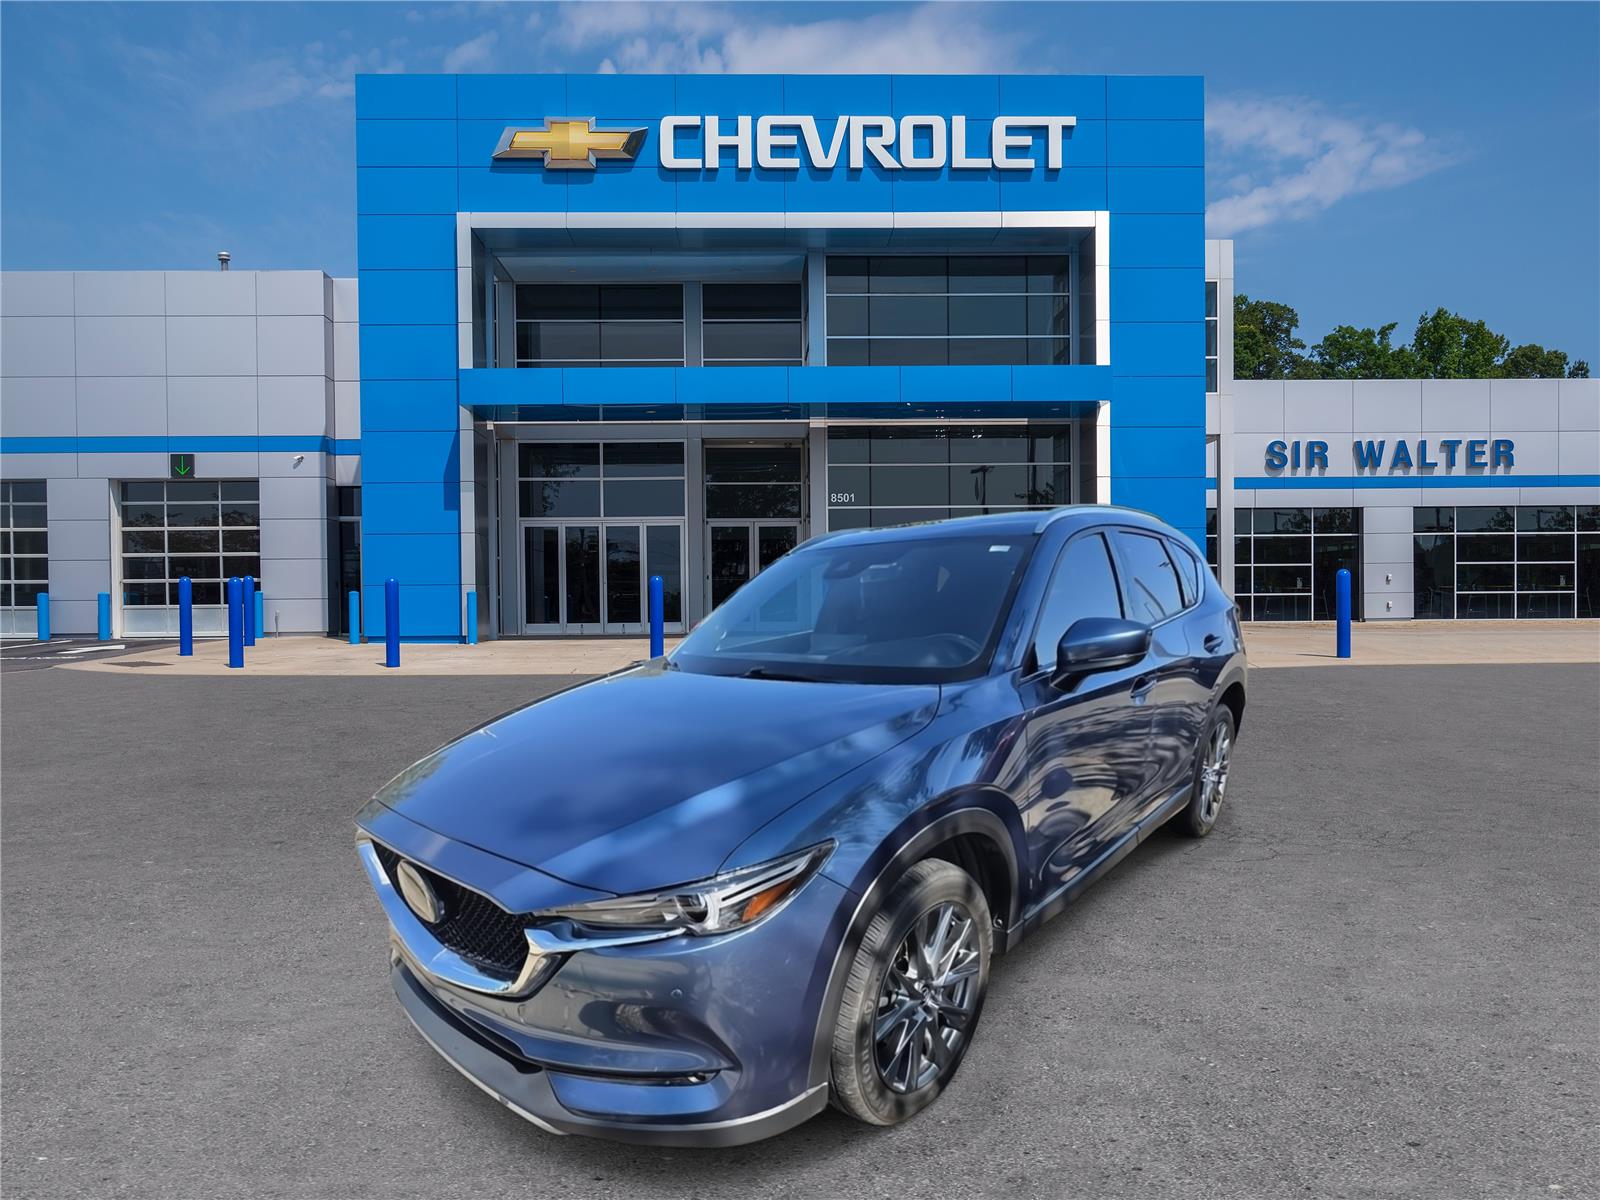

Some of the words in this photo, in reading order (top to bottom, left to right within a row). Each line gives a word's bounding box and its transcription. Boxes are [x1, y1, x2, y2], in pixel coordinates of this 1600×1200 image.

[659, 115, 1077, 169] CHEVROLET
[1266, 440, 1329, 470] SIR
[1353, 439, 1515, 469] WALTER
[830, 493, 855, 503] 8501
